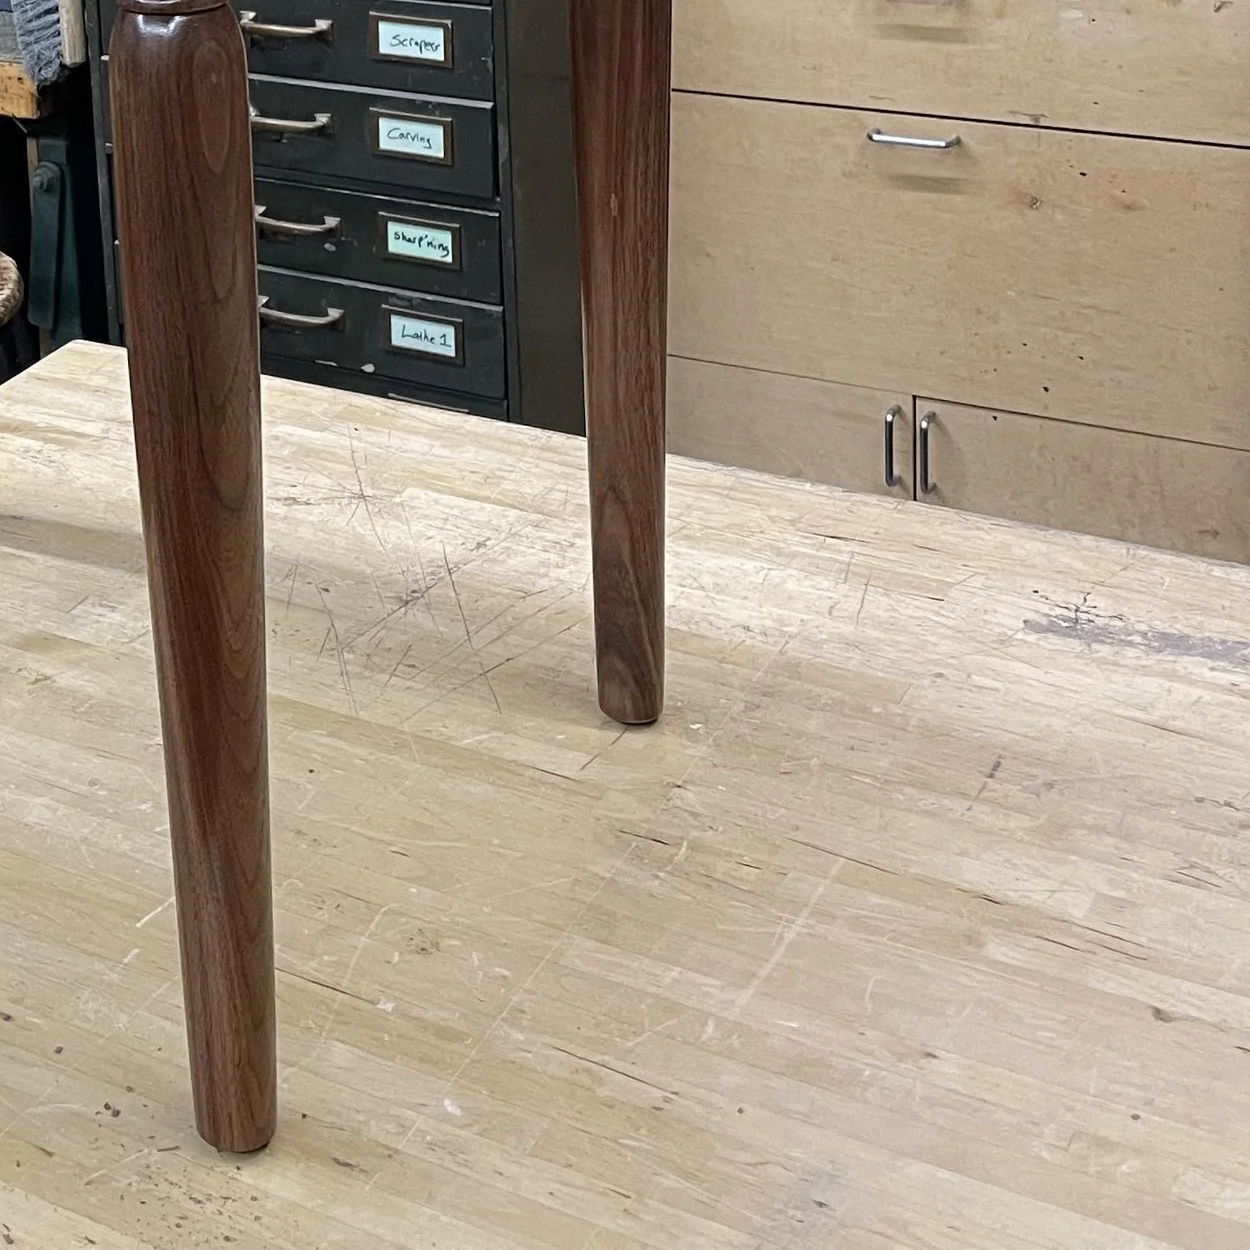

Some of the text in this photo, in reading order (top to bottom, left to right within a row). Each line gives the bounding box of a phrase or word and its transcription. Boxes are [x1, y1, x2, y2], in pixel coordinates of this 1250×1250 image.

[387, 127, 433, 150] Carving
[401, 324, 452, 348] Lathe 1
